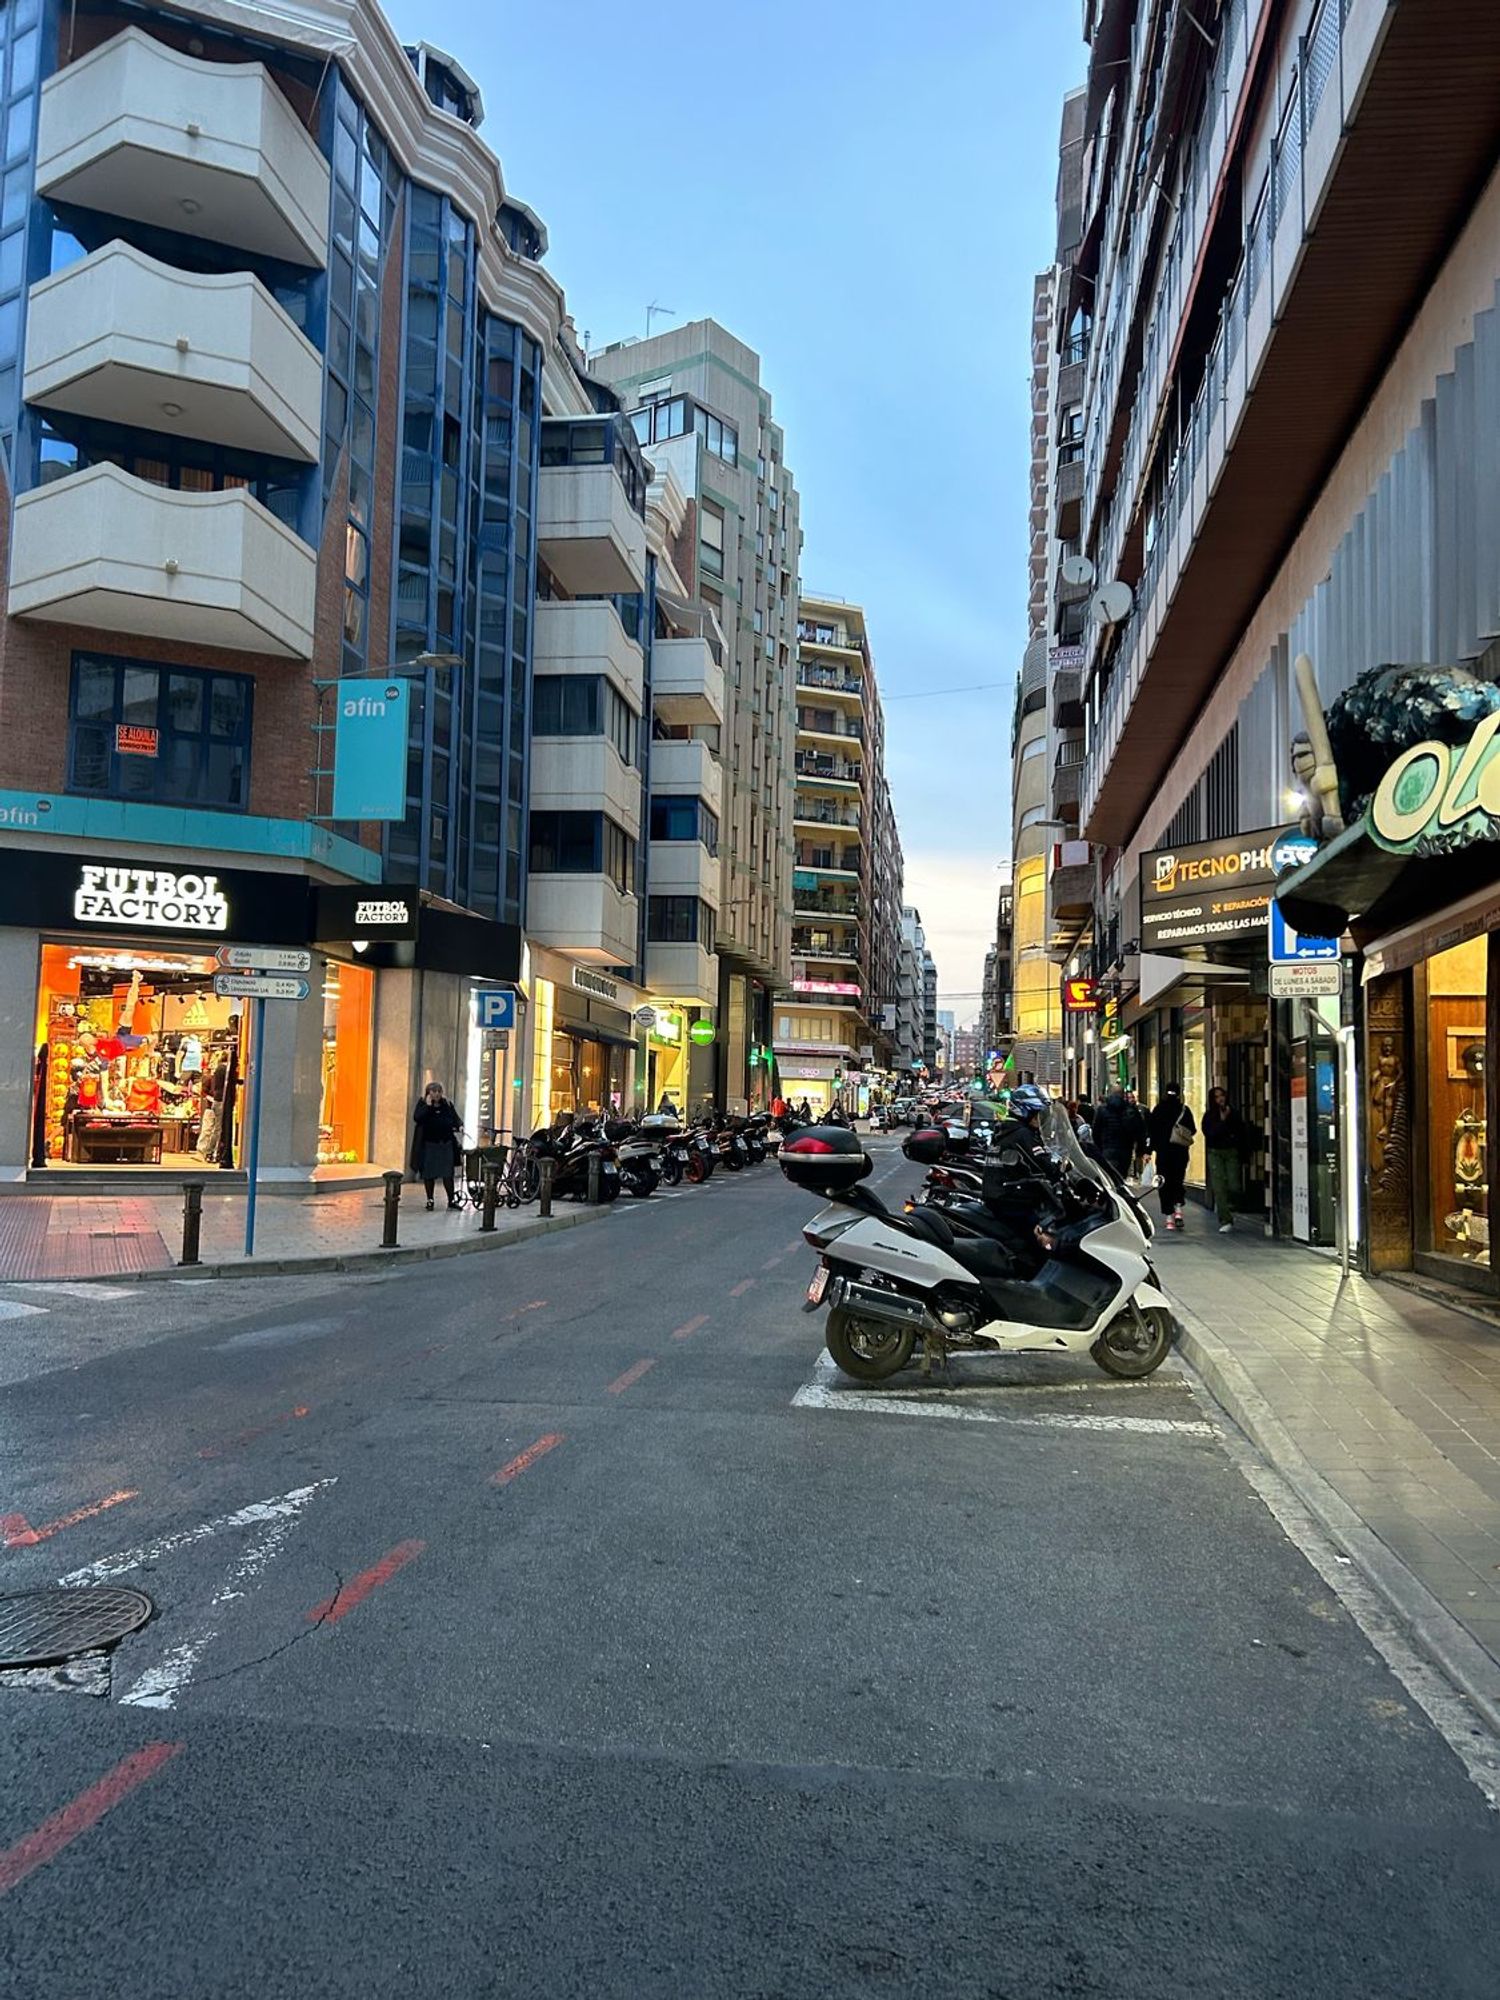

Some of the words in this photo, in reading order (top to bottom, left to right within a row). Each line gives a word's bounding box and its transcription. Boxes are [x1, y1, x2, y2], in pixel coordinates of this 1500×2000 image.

[343, 697, 386, 717] afin
[80, 865, 225, 902] FUTBOL
[80, 895, 222, 925] FACTORY
[357, 901, 407, 912] FUTBOL
[358, 913, 406, 921] FACTORY
[1143, 912, 1172, 924] SERVICIO
[1157, 925, 1205, 940] REPARAMOS
[1206, 920, 1233, 933] TODAS
[1234, 918, 1251, 929] LAS
[484, 996, 507, 1024] P
